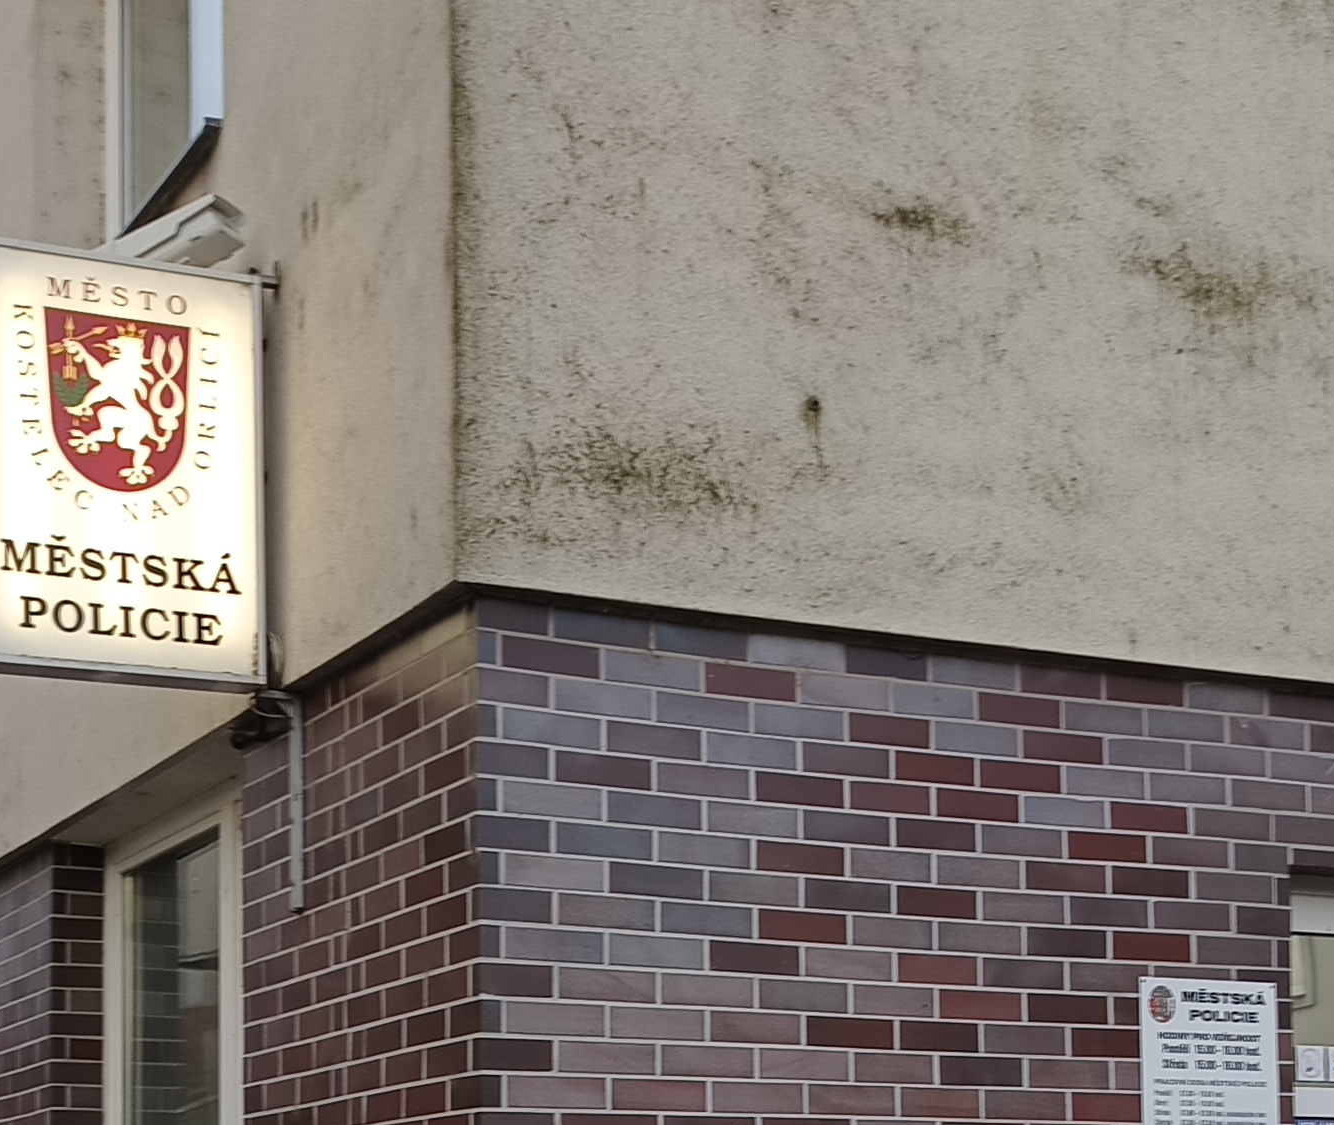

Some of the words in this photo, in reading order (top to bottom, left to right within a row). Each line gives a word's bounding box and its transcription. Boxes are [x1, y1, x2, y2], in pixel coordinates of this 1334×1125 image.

[46, 276, 188, 315] MĚSTO
[13, 303, 94, 510] KOSTELEC
[122, 486, 190, 521] NAD
[0, 534, 243, 596] MĚSTSKÁ
[18, 595, 224, 647] POLICIE
[1180, 988, 1266, 1006] MĚSTSKÁ
[1188, 1009, 1260, 1024] POLICIE
